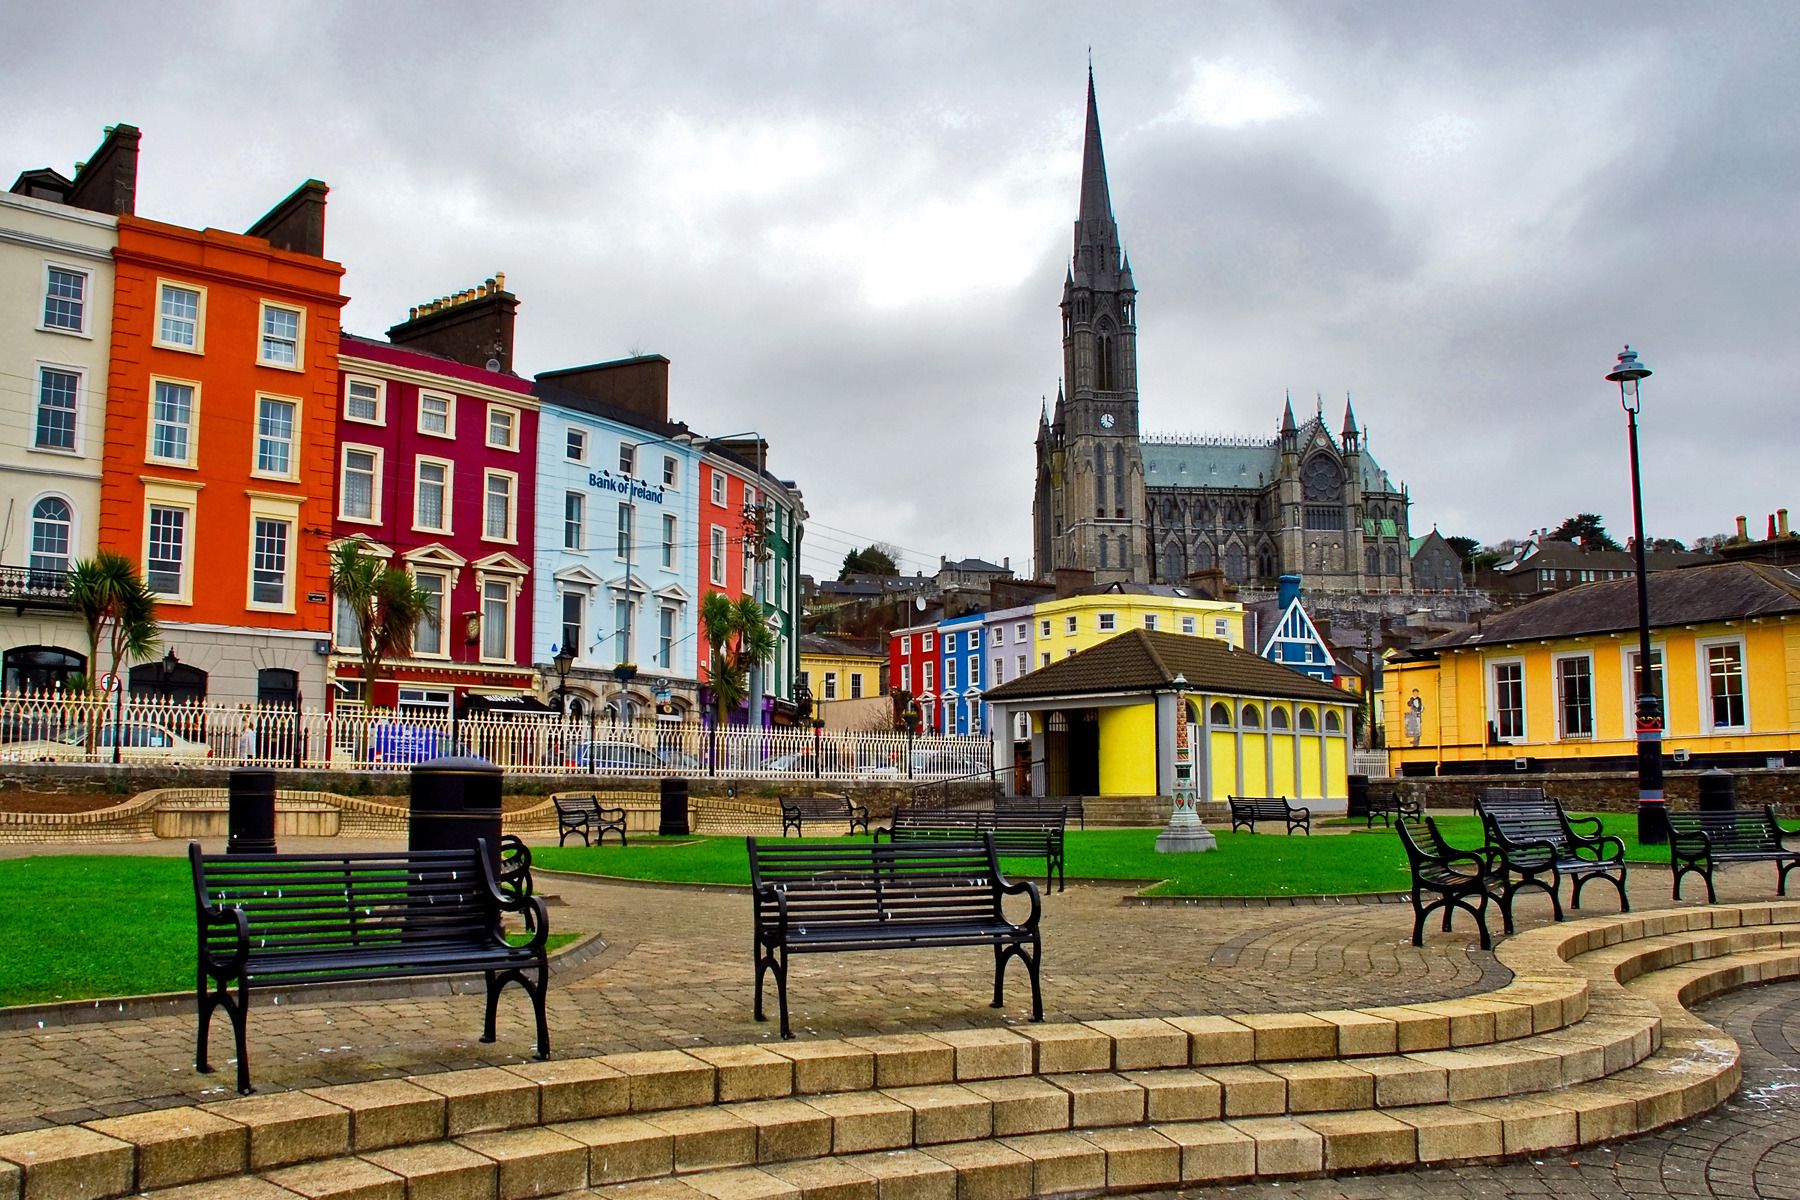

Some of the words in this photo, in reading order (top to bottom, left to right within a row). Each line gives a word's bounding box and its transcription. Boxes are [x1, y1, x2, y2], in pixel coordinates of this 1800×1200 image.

[589, 473, 615, 491] Bank
[617, 482, 630, 494] of
[631, 483, 662, 503] Ireland
